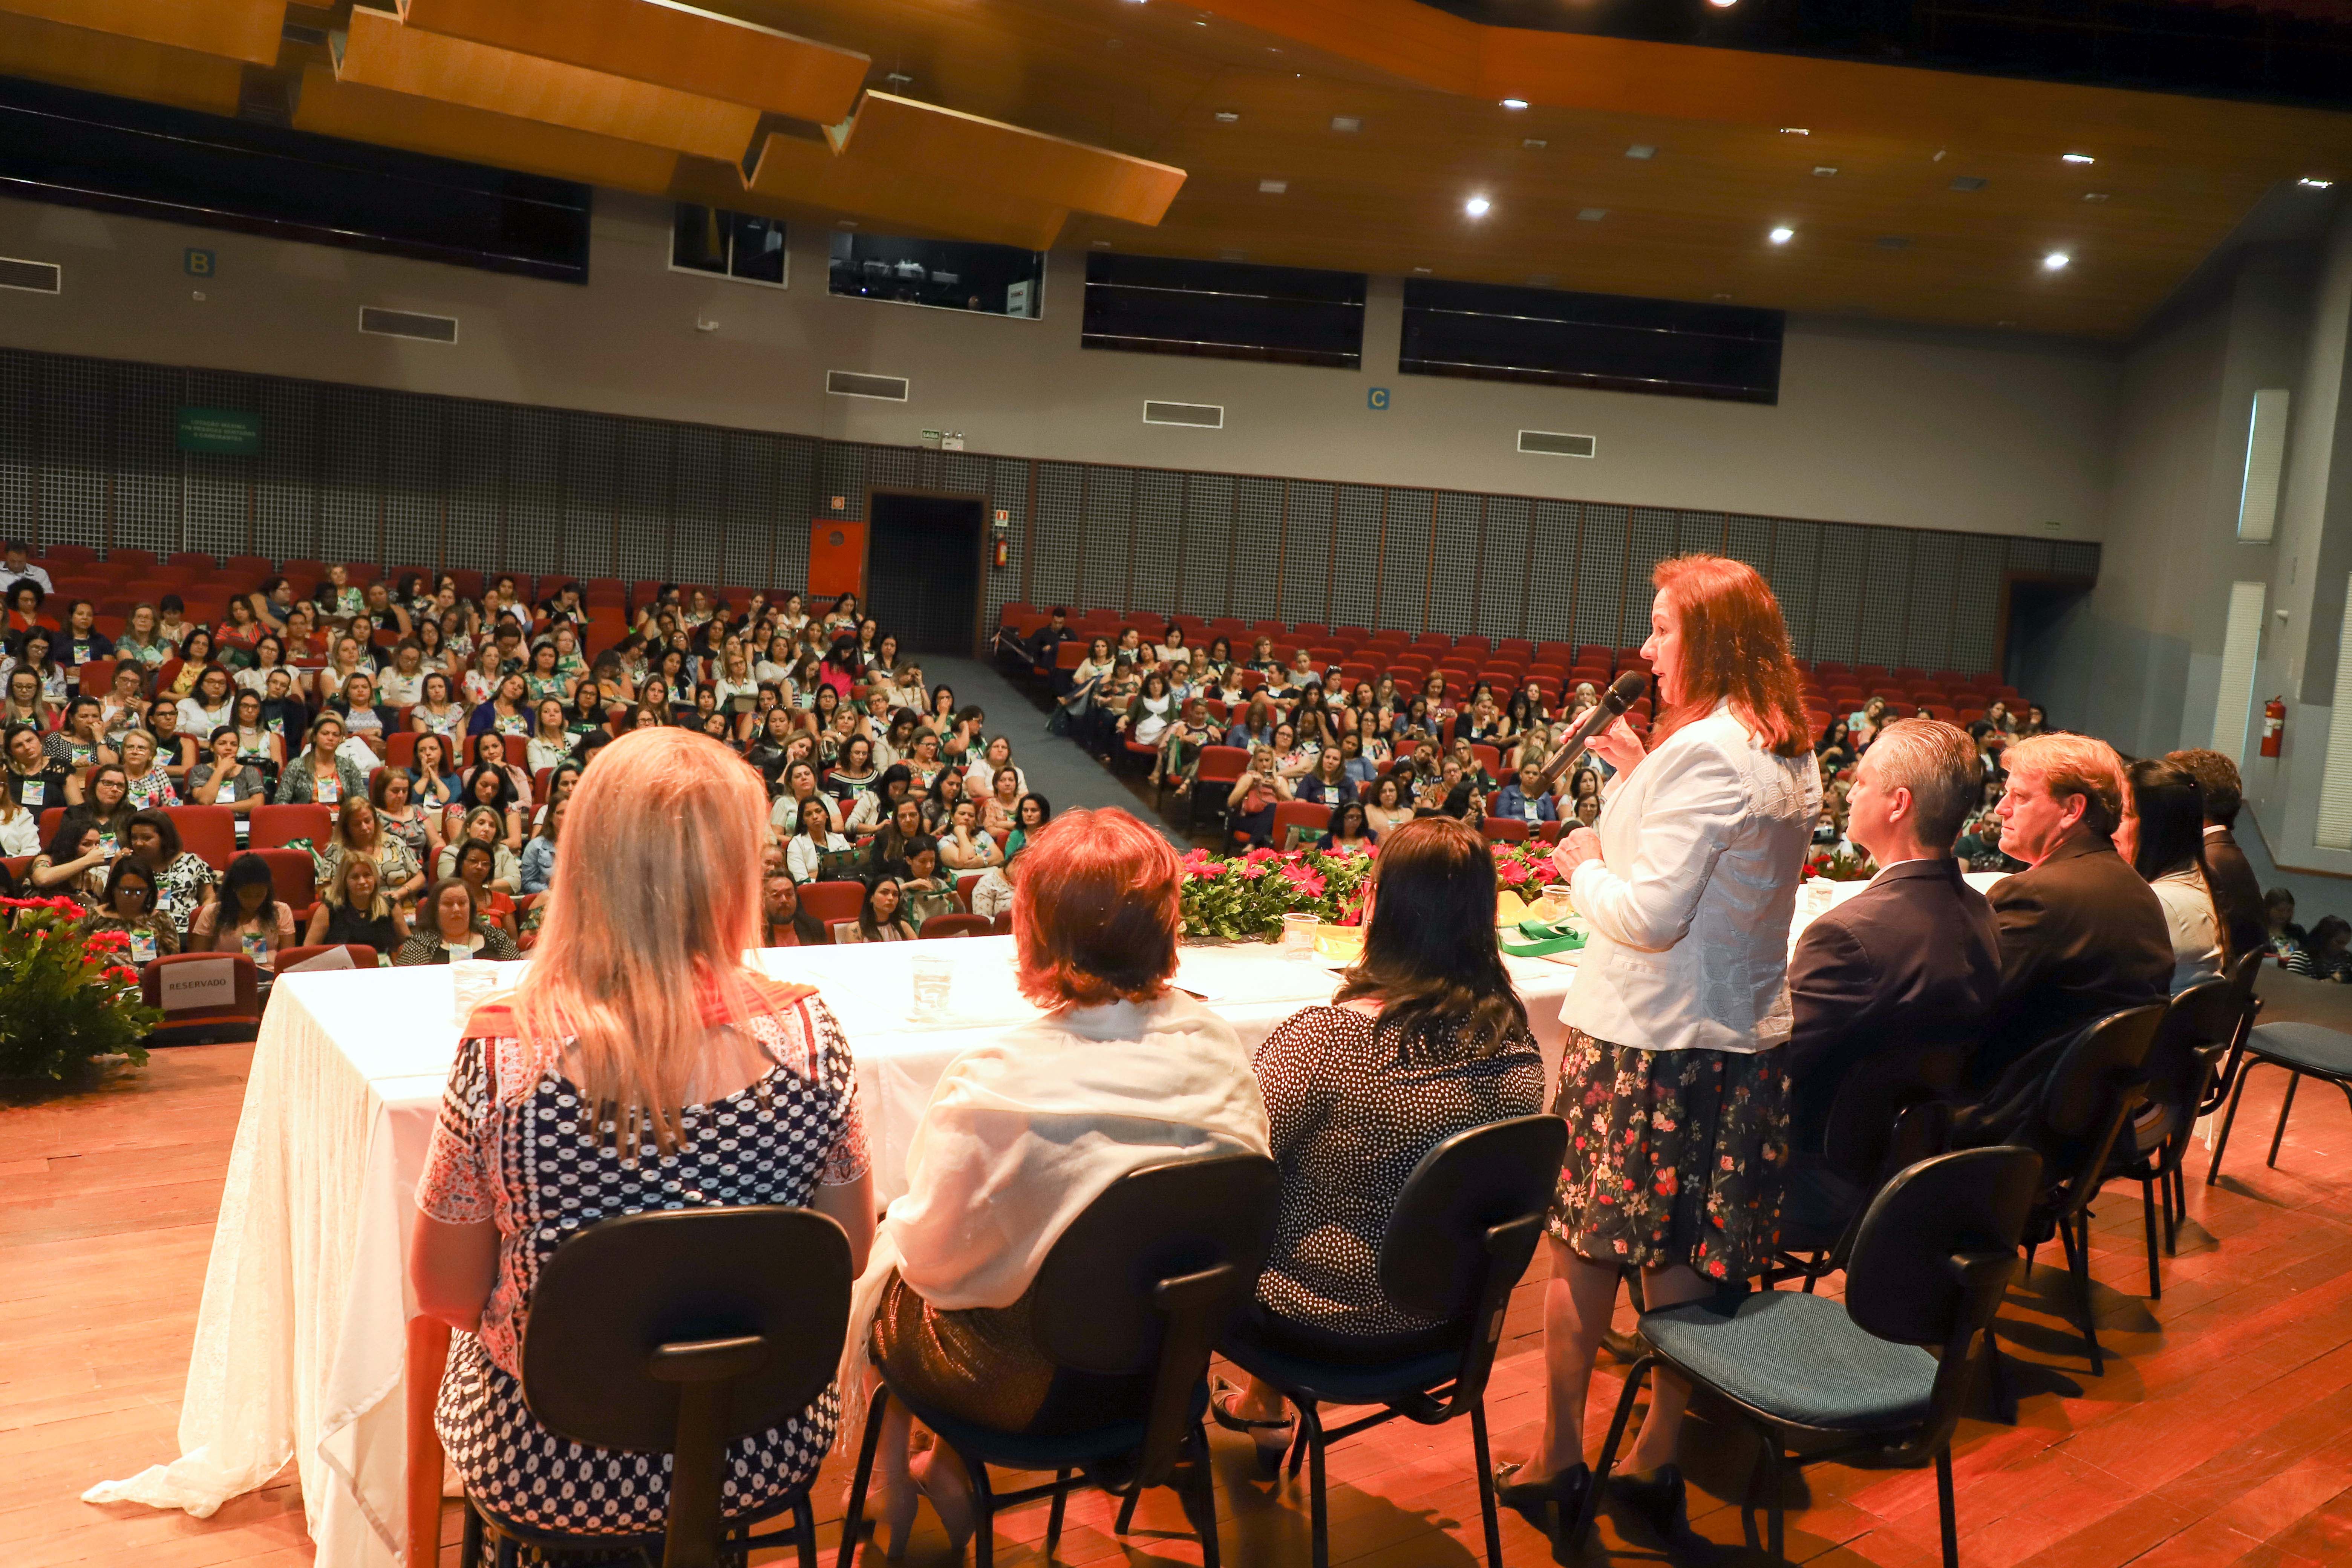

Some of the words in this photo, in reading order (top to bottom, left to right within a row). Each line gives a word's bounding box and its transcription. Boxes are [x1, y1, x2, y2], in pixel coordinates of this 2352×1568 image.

[191, 253, 208, 273] B
[1372, 390, 1385, 407] C
[169, 978, 226, 991] RESERVADO
